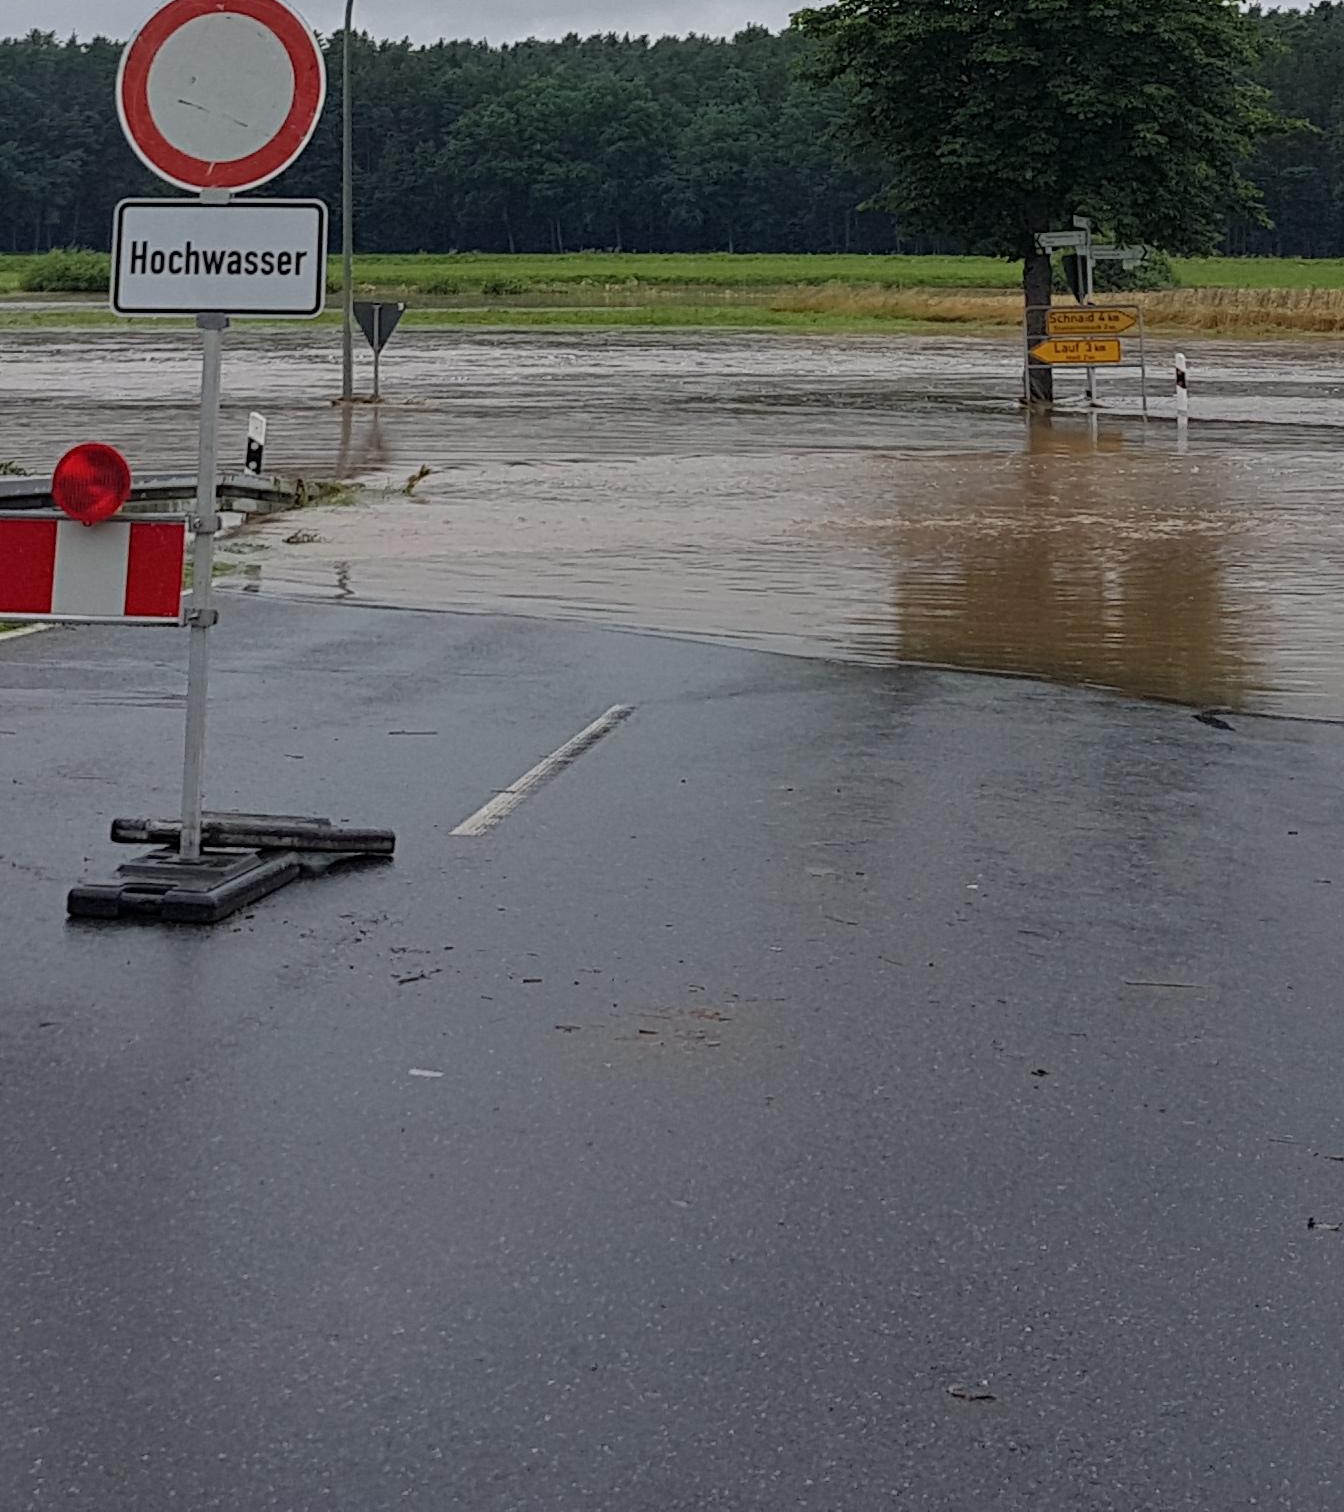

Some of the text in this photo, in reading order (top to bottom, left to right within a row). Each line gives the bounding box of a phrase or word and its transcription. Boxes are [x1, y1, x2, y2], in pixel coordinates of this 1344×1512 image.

[130, 241, 307, 276] Hochwasser
[1049, 312, 1095, 324] Schnaid
[1054, 342, 1080, 353] Lauf
